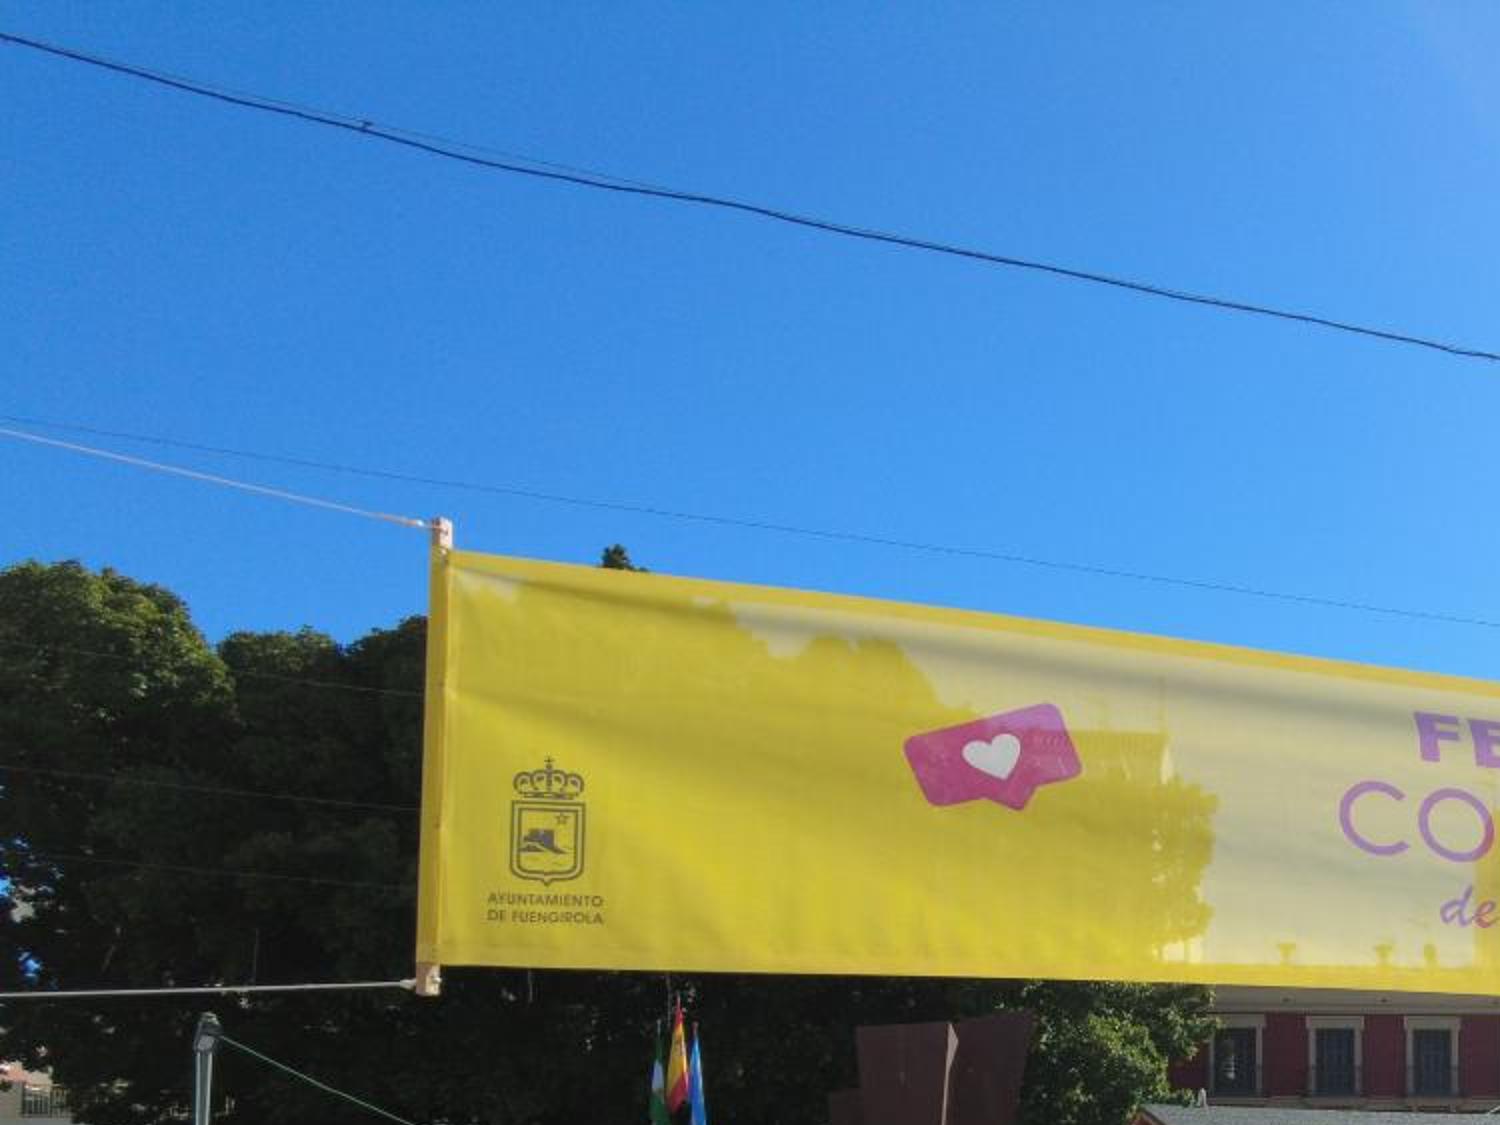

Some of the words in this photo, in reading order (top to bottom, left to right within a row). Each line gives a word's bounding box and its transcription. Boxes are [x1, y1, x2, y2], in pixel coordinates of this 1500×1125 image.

[487, 893, 603, 907] AYUNTAMIENTO
[1440, 886, 1499, 928] de
[487, 909, 506, 922] DE
[512, 911, 603, 925] FUENGIROLA
